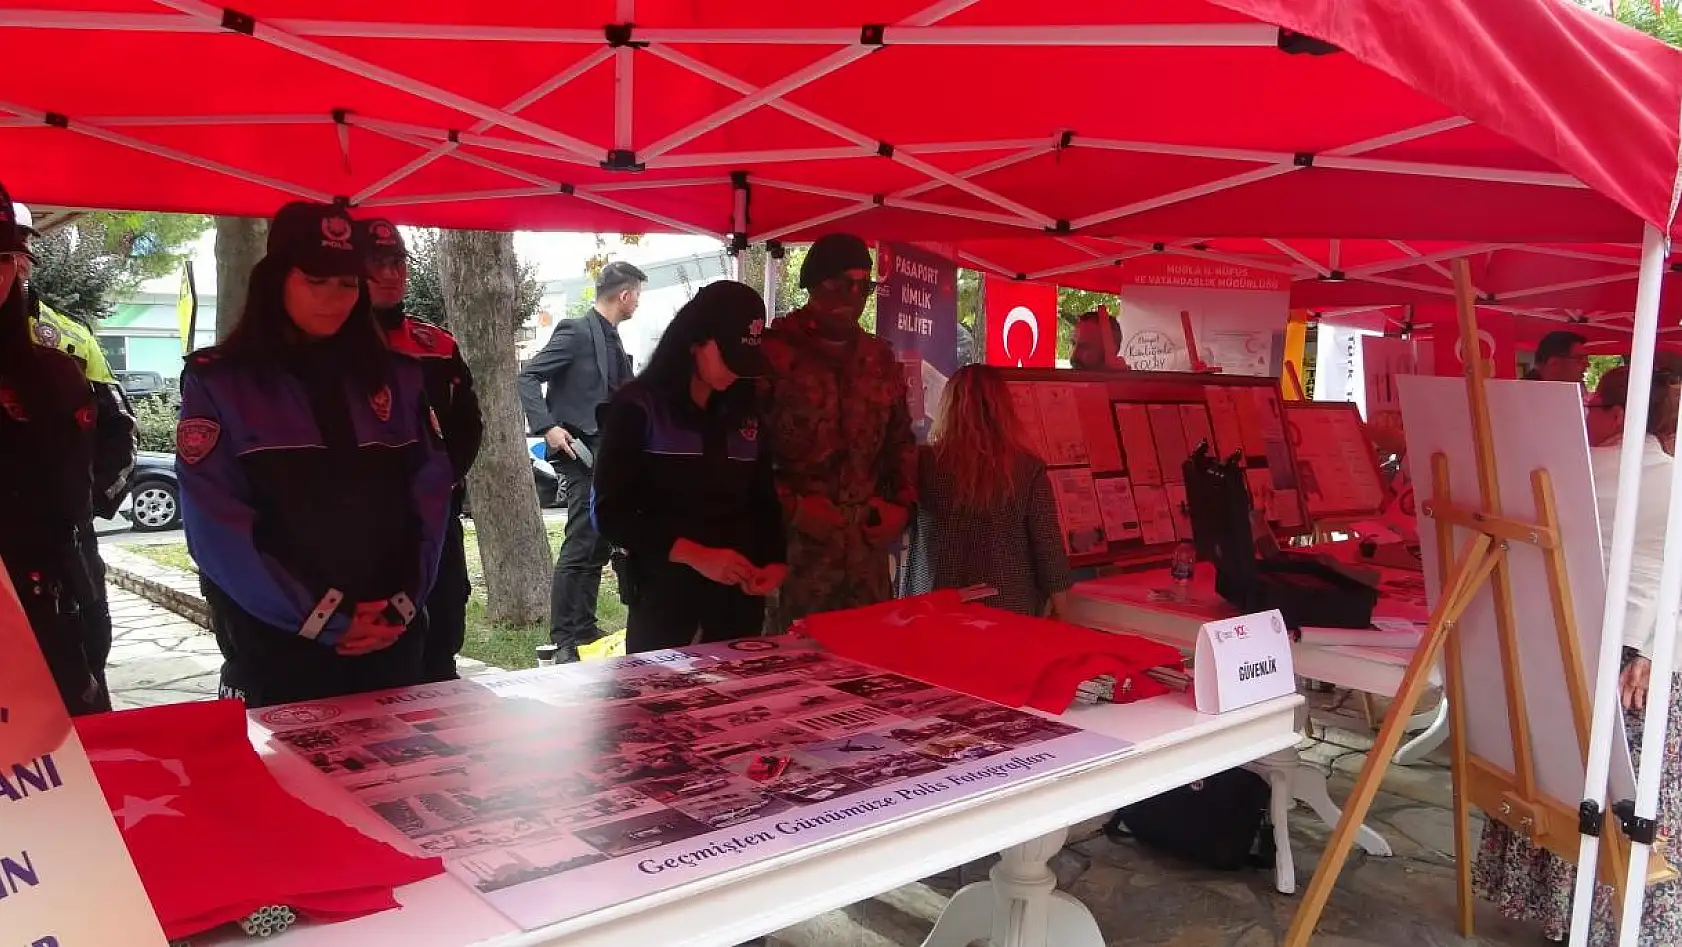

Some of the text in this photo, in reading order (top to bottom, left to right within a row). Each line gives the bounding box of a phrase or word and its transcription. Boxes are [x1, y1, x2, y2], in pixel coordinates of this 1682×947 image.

[896, 255, 939, 284] PASAPORT
[1135, 275, 1146, 284] VE
[901, 283, 932, 310] KİMLİK
[897, 312, 933, 336] EHLİYET
[1239, 656, 1277, 681] GÜVENLİK
[637, 831, 776, 875] Geçmişten
[775, 796, 897, 835] Günümüze
[947, 751, 1058, 786] Fotoğrafları
